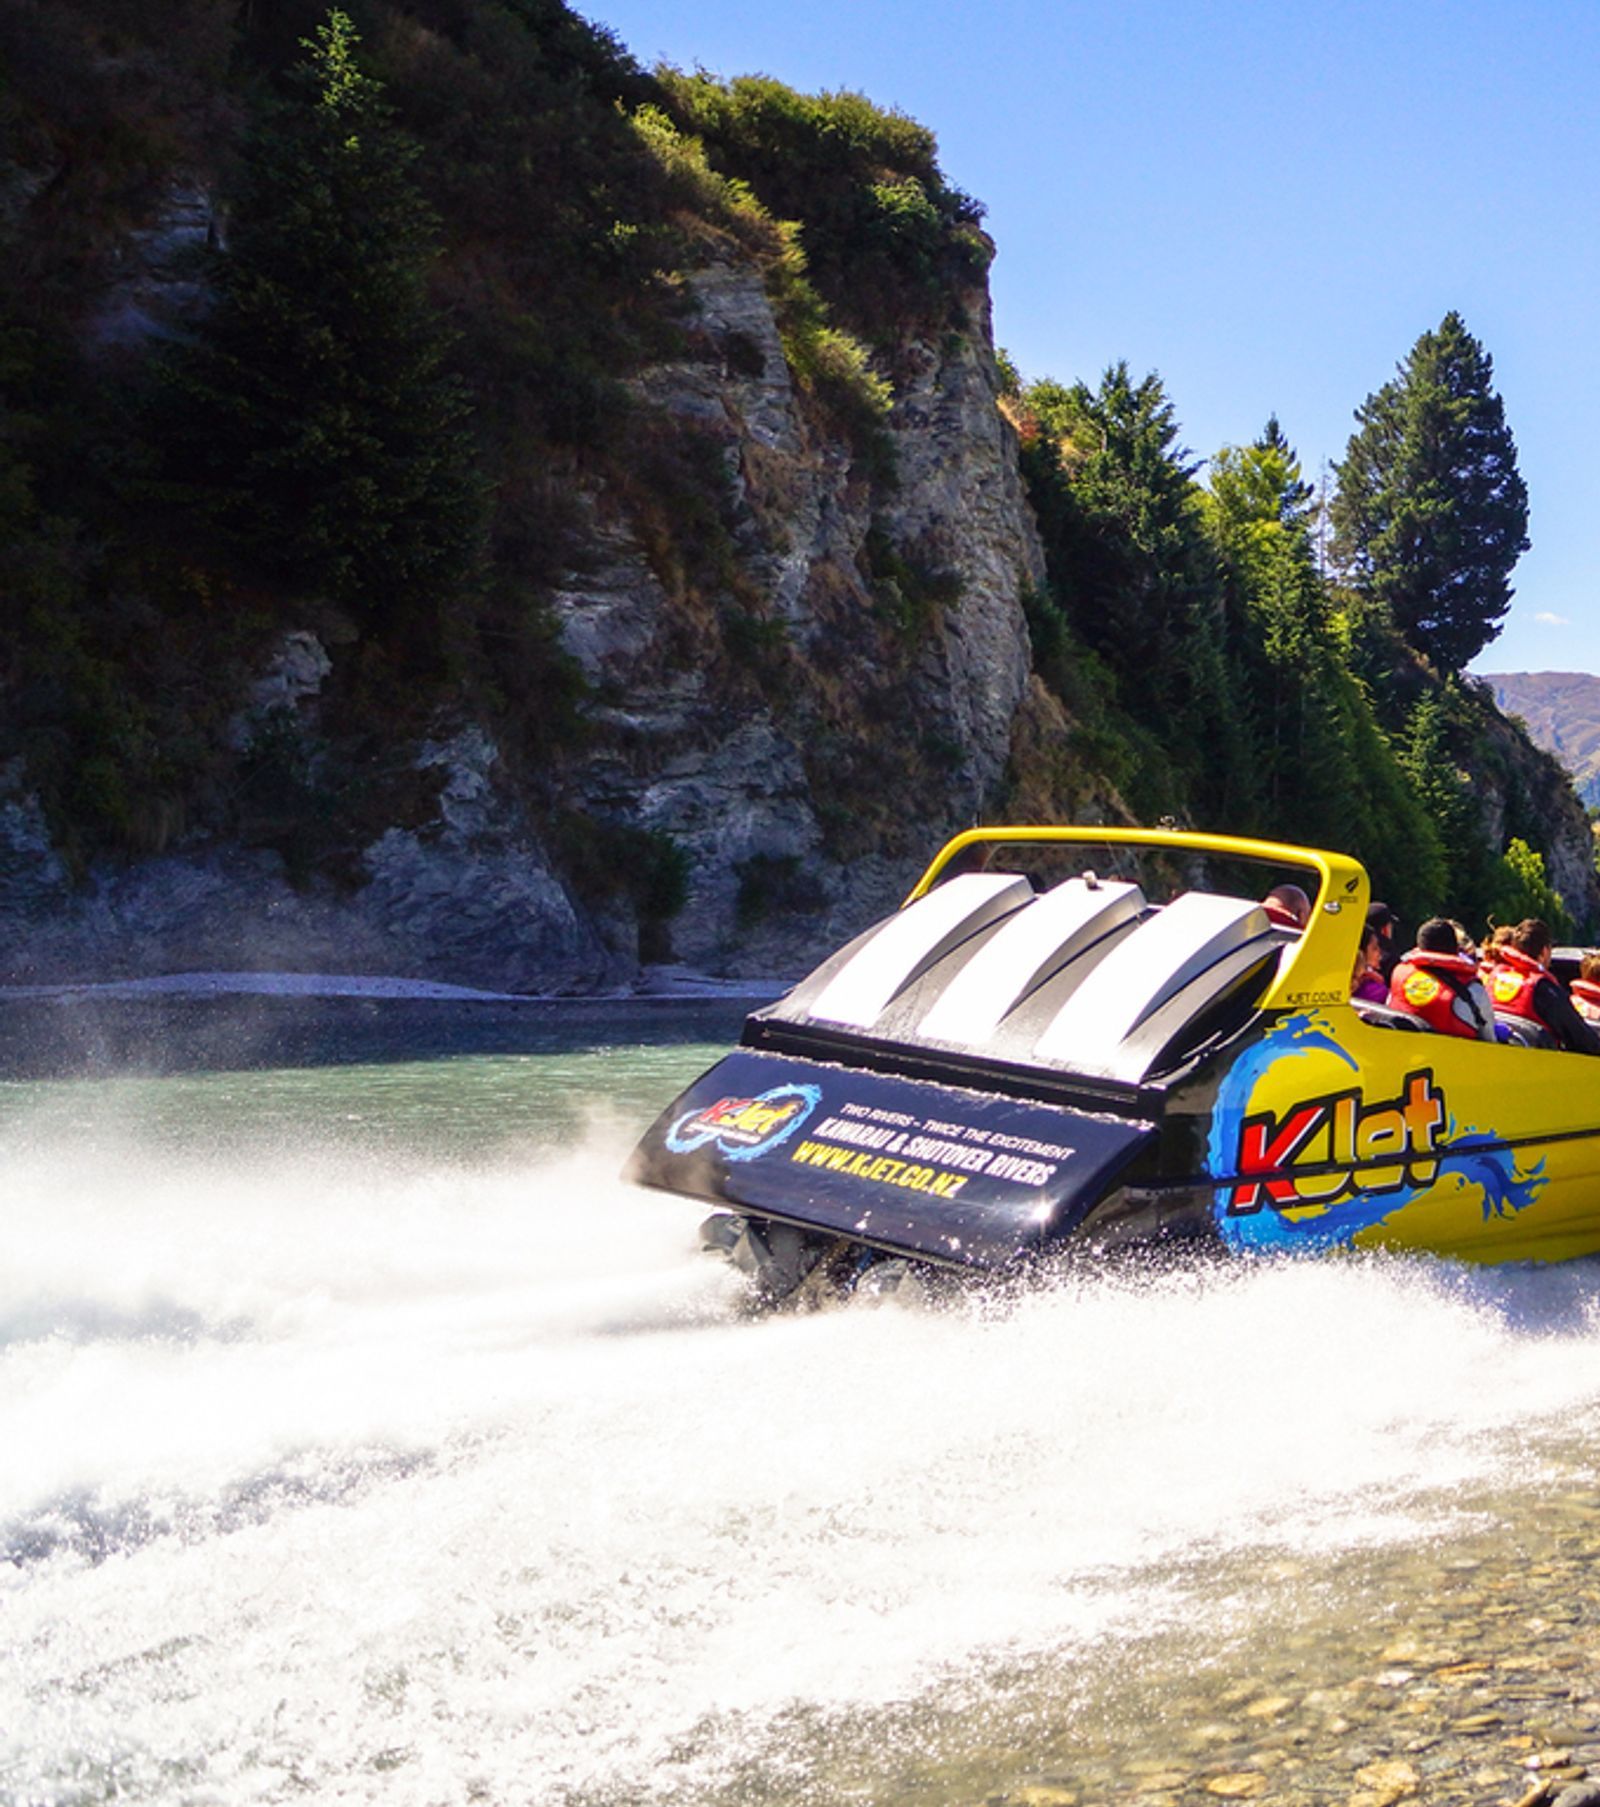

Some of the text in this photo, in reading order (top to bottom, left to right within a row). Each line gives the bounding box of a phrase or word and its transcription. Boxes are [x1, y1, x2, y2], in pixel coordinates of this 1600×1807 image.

[698, 1097, 802, 1135] KJet
[840, 1103, 869, 1118] TWO
[868, 1108, 914, 1127] RIVERS
[922, 1119, 965, 1137] TWICE
[963, 1127, 991, 1143] THE
[988, 1132, 1076, 1160] EXCITEMENT
[791, 1140, 968, 1199] WWW.KJET.CO.NZ
[812, 1117, 1057, 1186] KAWARAU & SHOTOVER RIVERS
